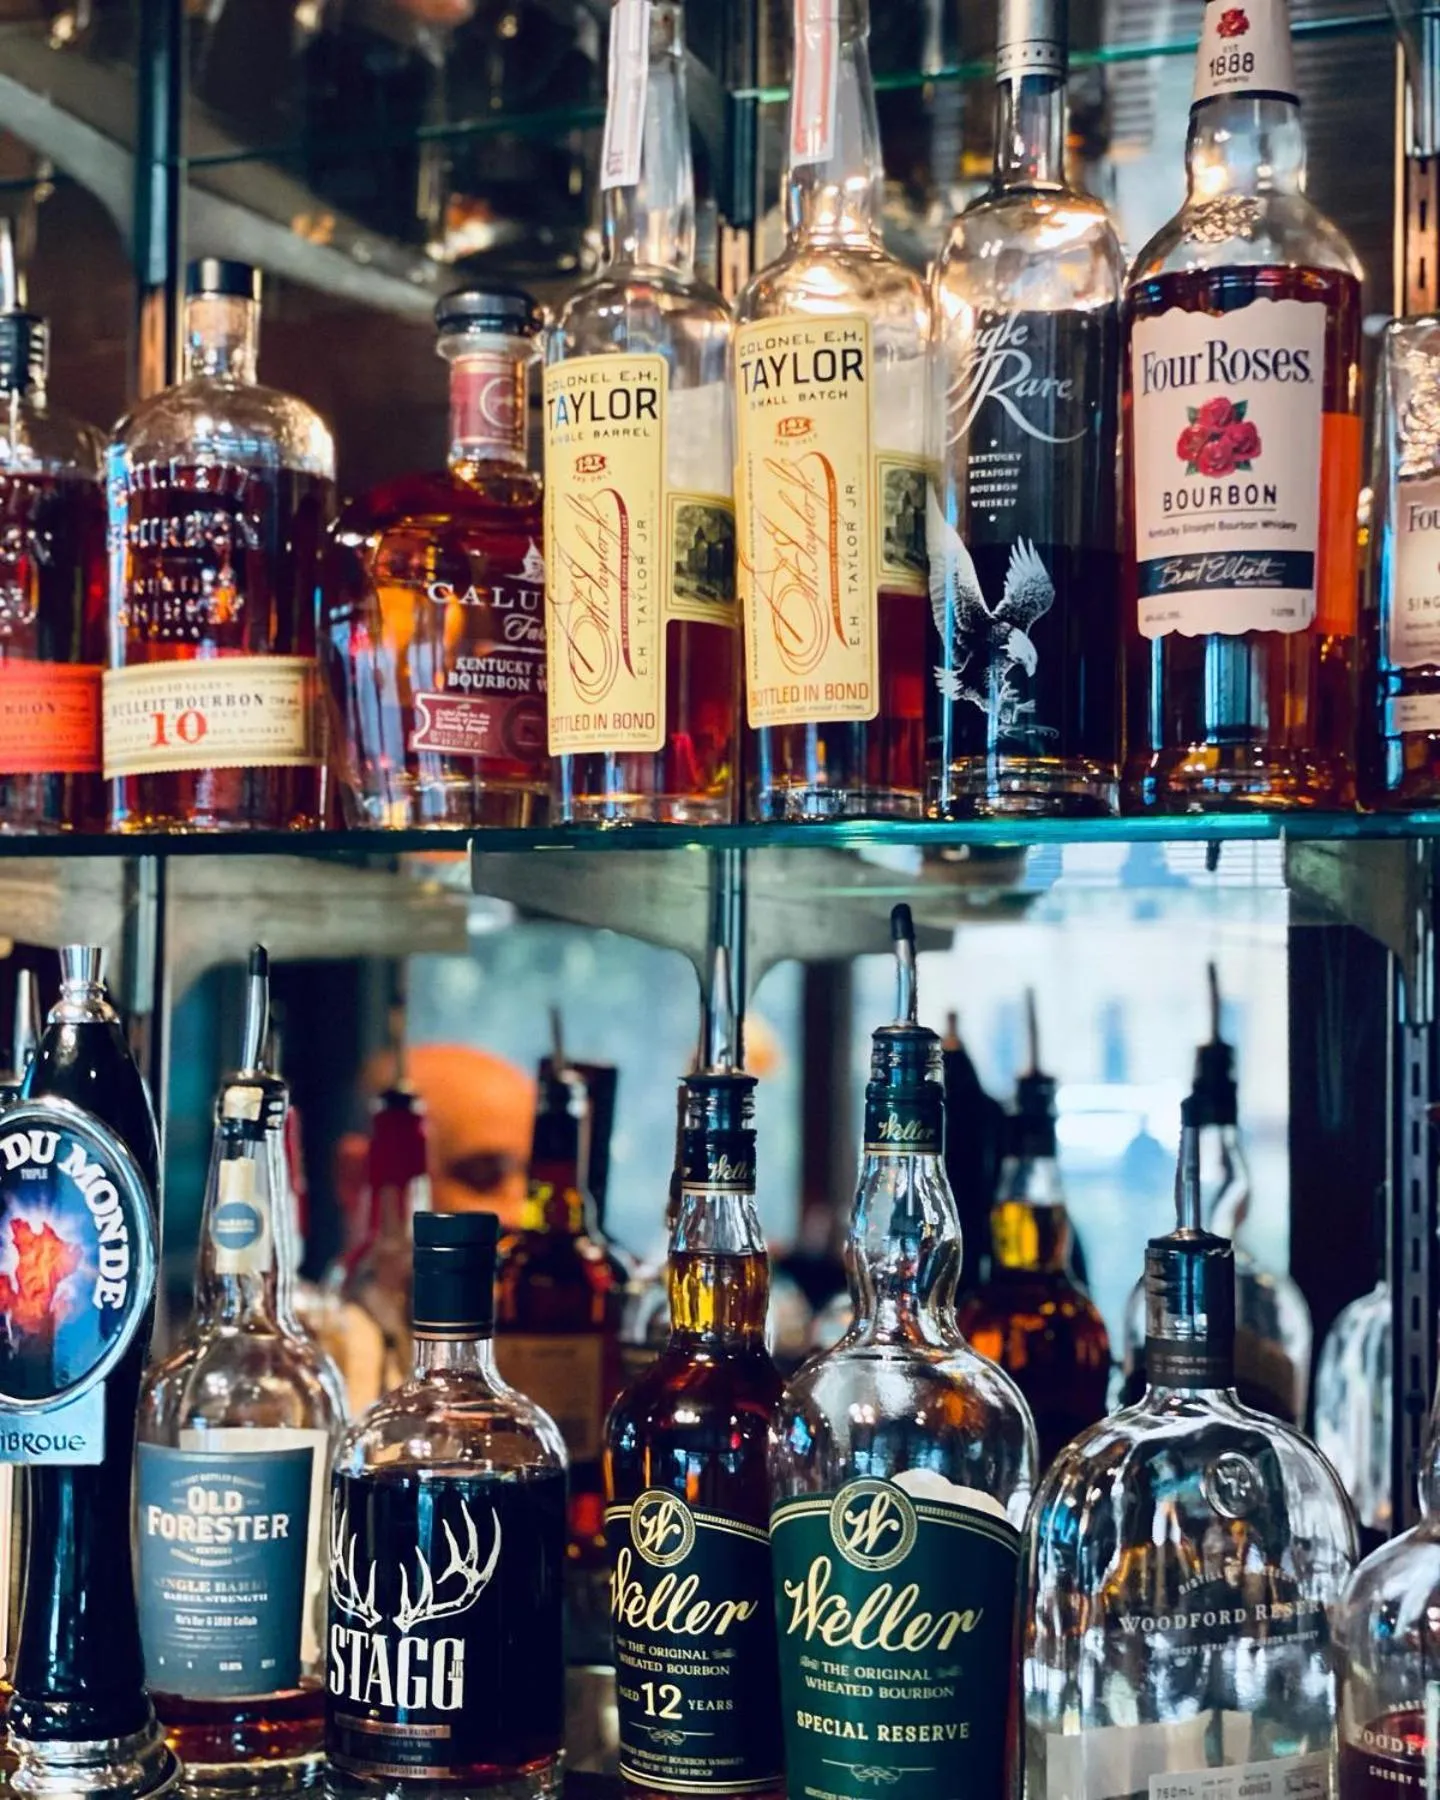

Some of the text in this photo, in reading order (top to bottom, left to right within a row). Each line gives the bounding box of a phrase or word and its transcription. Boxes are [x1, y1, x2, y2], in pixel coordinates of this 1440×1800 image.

[1209, 52, 1255, 78] 1888
[740, 330, 864, 357] COLONEL E.H.
[619, 370, 659, 382] E.H.
[740, 348, 865, 395] TAYLOR
[1142, 340, 1311, 396] Four Roses
[546, 388, 659, 431] TAYLOR
[751, 390, 848, 410] SMALL BATCH
[593, 427, 651, 439] BARREL
[968, 453, 1022, 465] KENTUCKY
[969, 467, 1020, 479] STRAIGHT
[969, 482, 1019, 494] BOURBON
[1163, 484, 1278, 512] BOURBON
[971, 497, 1017, 508] WHISKEY
[846, 522, 859, 594] TAYLOR
[427, 581, 541, 611] CALU
[636, 555, 648, 627] TAYLOR
[455, 656, 534, 676] KENTUCKY
[446, 671, 530, 691] BOURBON
[804, 684, 819, 702] IN
[824, 682, 870, 701] BOND
[174, 692, 264, 711] BOURBON
[151, 709, 208, 748] 10
[593, 712, 608, 730] IN
[612, 711, 656, 731] BOND
[877, 1112, 936, 1141] Weller
[0, 1129, 129, 1309] DU MONDE
[187, 1485, 244, 1516] OLD
[147, 1504, 291, 1544] FORESTER
[203, 1593, 269, 1604] STRENGTH
[609, 1547, 759, 1636] Weller
[783, 1555, 984, 1652] Weller
[1118, 1607, 1248, 1635] WOODFORD
[628, 1640, 710, 1661] THE ORIGINAL
[329, 1623, 466, 1711] STAGG
[619, 1651, 731, 1677] WHEATED BOURBON
[821, 1661, 933, 1682] THE ORIGINAL
[641, 1681, 684, 1721] 12
[687, 1698, 734, 1712] YEARS
[805, 1675, 956, 1701] WHEATED BOURBON
[796, 1709, 971, 1743] SPECIAL RESERVE
[1368, 1764, 1413, 1785] CHERRY
